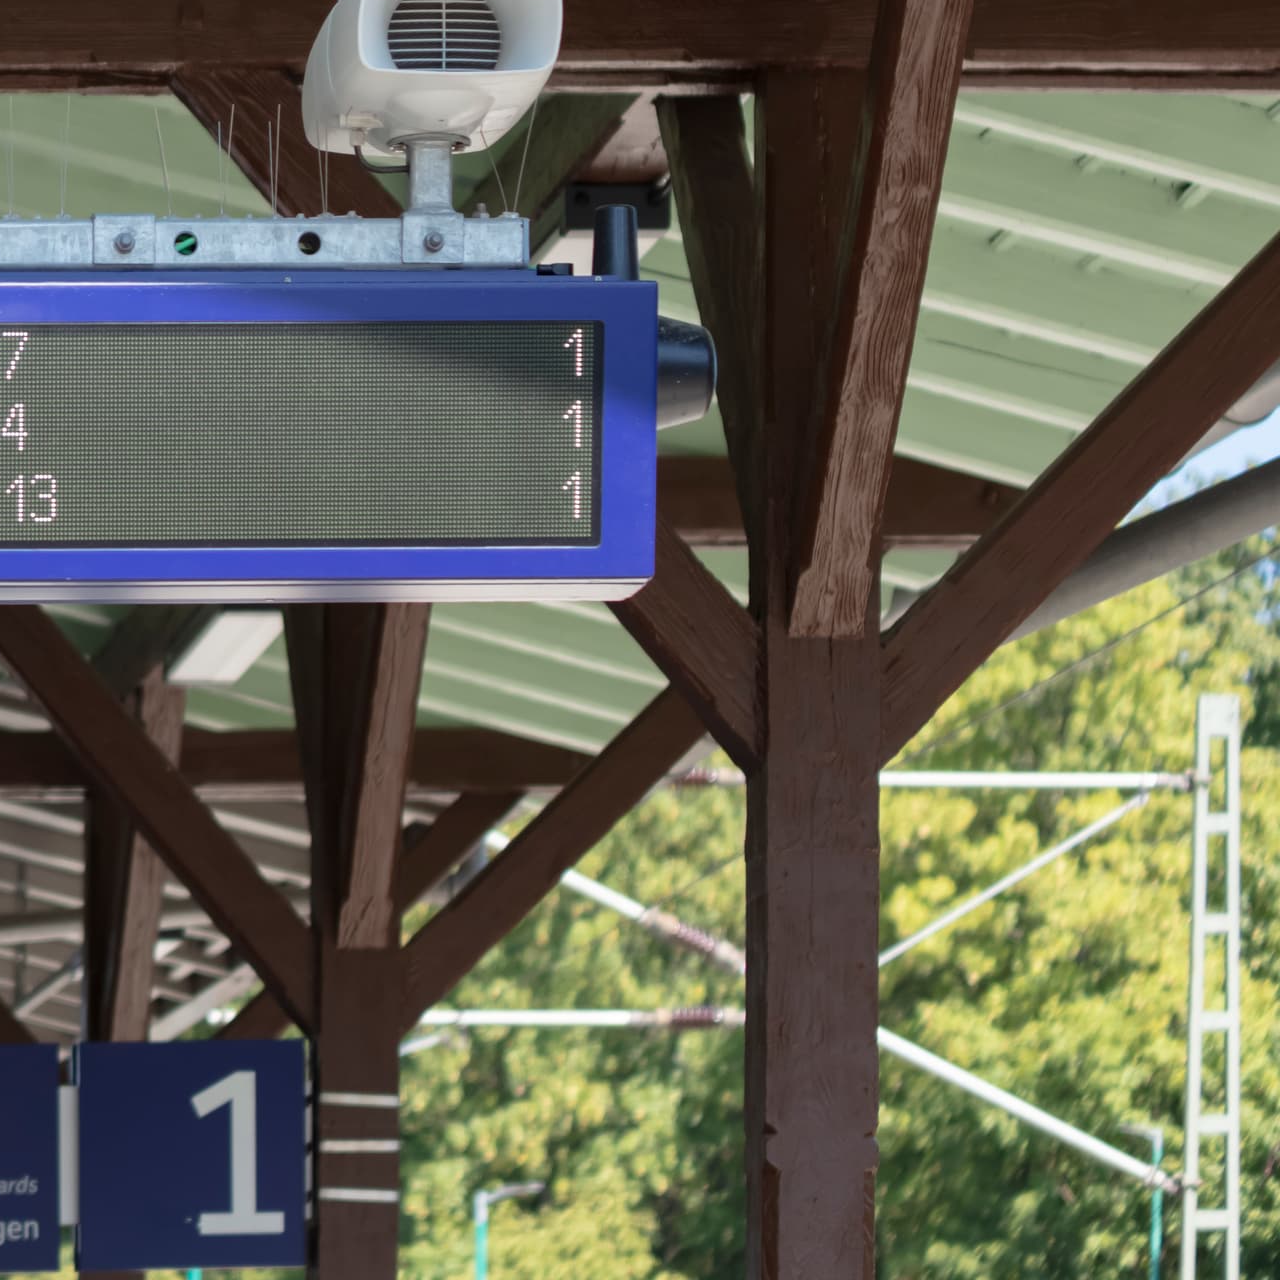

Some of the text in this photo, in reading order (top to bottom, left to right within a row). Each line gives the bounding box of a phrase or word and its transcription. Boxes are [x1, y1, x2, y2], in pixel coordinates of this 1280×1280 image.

[564, 328, 583, 377] 1
[563, 399, 582, 448] 1
[562, 470, 582, 519] 1
[190, 1070, 285, 1236] 1
